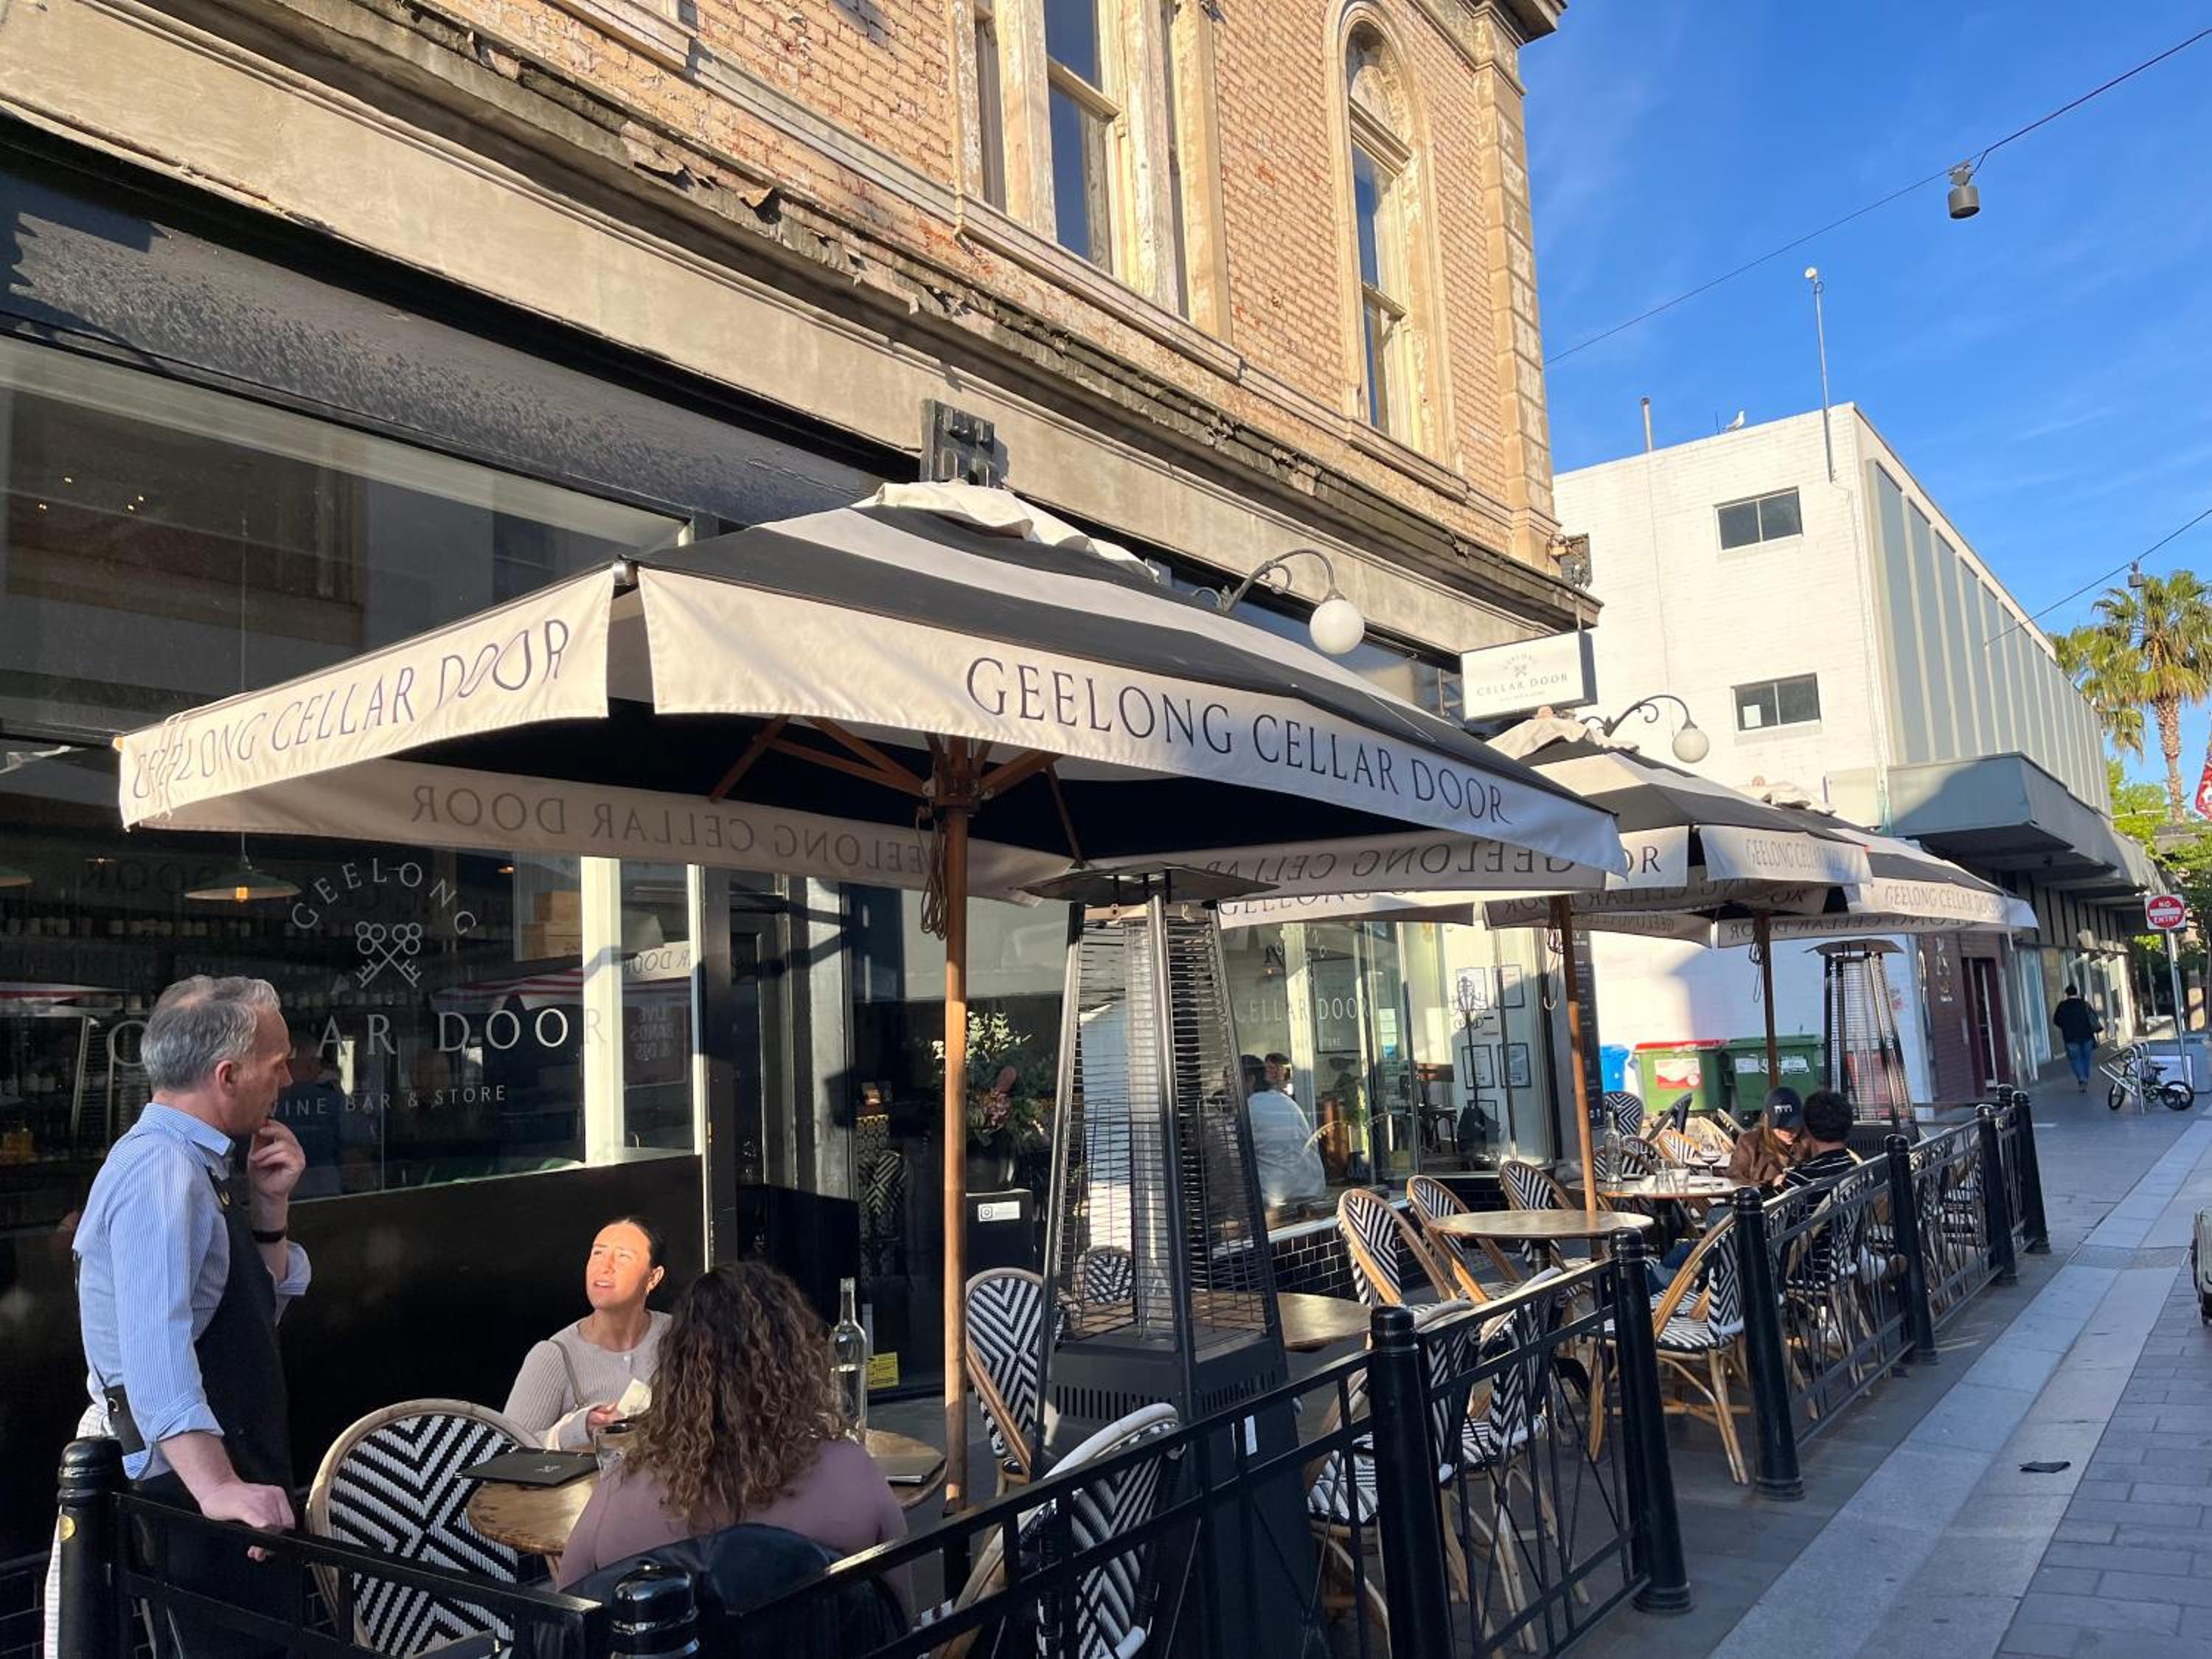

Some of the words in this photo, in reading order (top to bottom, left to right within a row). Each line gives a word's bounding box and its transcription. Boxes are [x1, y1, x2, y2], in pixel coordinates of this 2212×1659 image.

[271, 667, 416, 751] CELLAR
[436, 619, 569, 709] DOOR
[967, 657, 1232, 754] GEELONG
[1253, 714, 1399, 796] CELLAR
[1411, 758, 1514, 825] DOOR
[291, 858, 476, 935] GEELONG
[2154, 915, 2179, 924] ENTRY
[438, 1007, 607, 1052] DOOR
[345, 1093, 391, 1112] BAR
[408, 1092, 419, 1107] &
[434, 1085, 506, 1105] STORE
